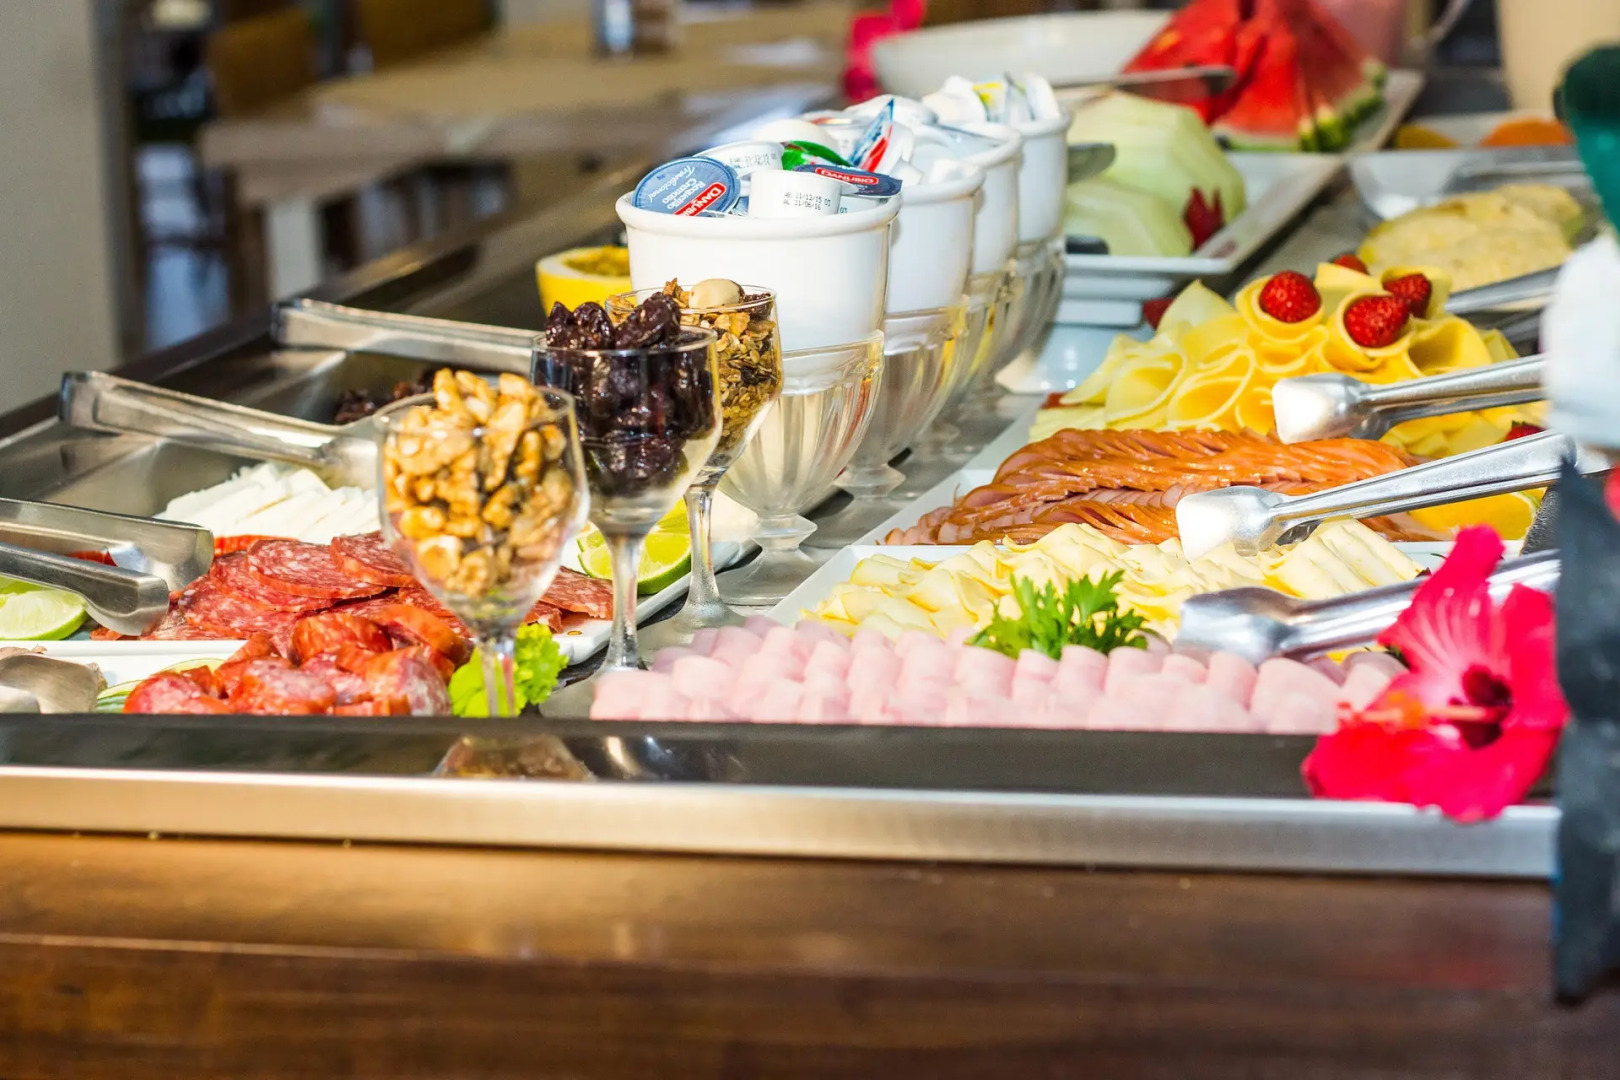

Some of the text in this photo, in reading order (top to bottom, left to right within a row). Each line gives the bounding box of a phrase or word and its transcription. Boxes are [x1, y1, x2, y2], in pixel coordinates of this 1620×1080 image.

[647, 165, 696, 204] Tradicional
[820, 169, 875, 184] DANUBIO
[661, 178, 698, 204] Cremoso
